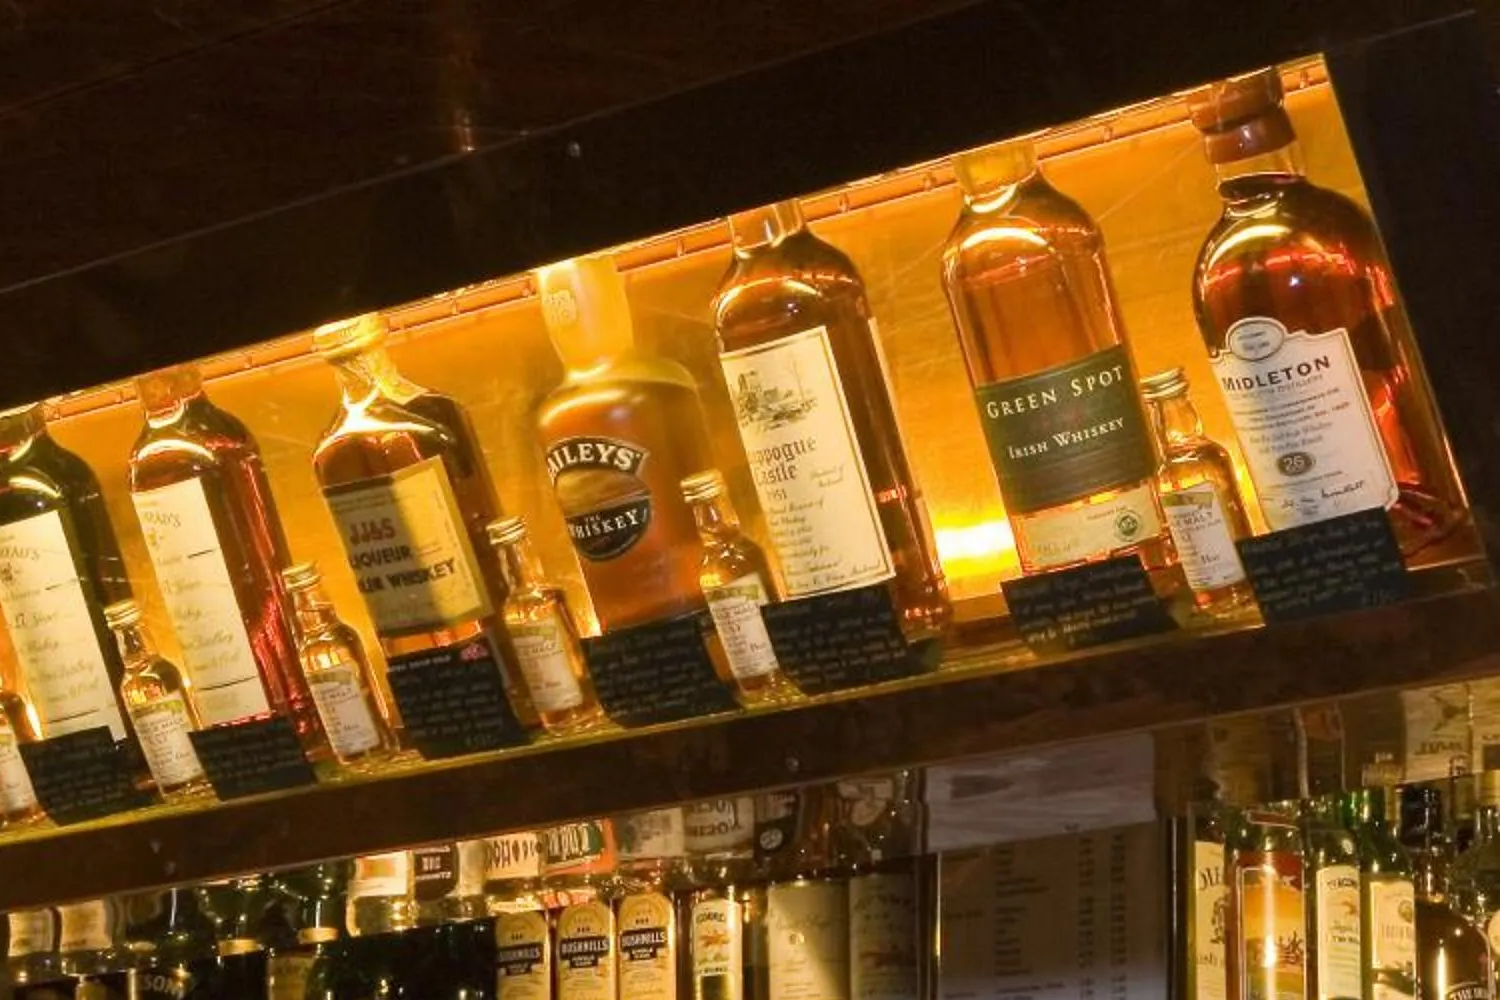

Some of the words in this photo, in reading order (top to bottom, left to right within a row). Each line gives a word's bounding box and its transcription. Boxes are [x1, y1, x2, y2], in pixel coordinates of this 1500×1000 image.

[986, 388, 1058, 420] GREEN
[1071, 365, 1125, 397] SPOT
[1222, 355, 1331, 391] MIDLETON
[1008, 441, 1049, 461] IRISH
[1052, 417, 1125, 448] WHISKEY
